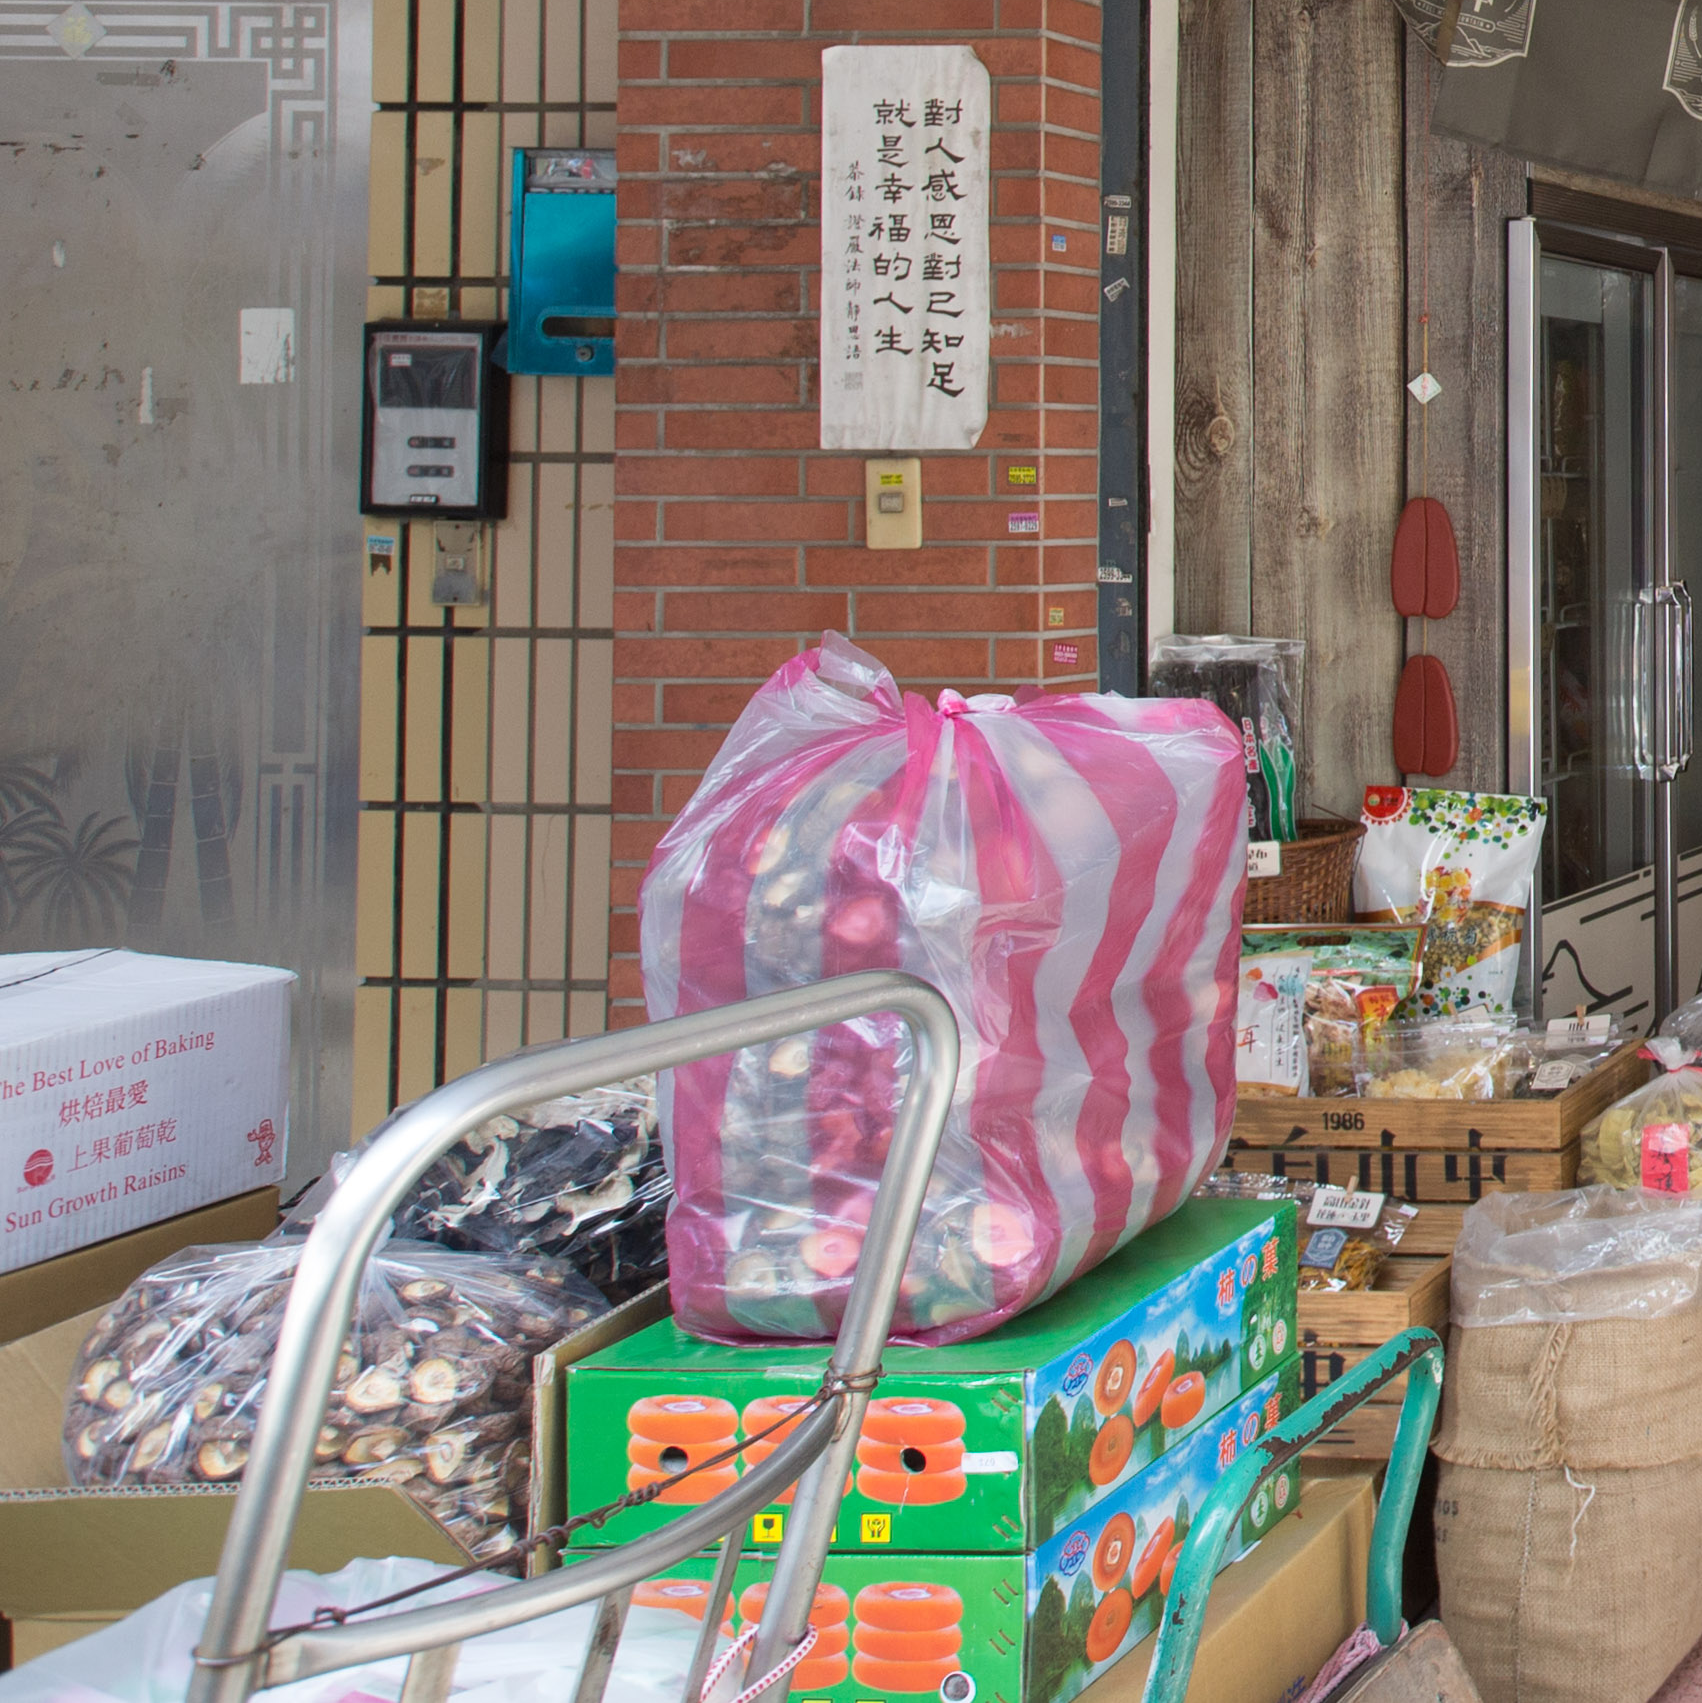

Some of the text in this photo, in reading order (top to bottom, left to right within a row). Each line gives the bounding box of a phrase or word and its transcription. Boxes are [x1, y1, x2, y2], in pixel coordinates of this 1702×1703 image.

[868, 99, 914, 355] 就是幸福的人生
[921, 99, 966, 397] 對人感恩對己知足
[0, 1030, 215, 1099] he Best Love of Baking
[59, 1079, 149, 1128] 烘焙最愛
[1322, 1112, 1365, 1131] 1986
[66, 1117, 178, 1173] 上果葡萄乾
[5, 1163, 186, 1233] Sun Growth Raisins
[1217, 1235, 1280, 1307] 柿の菓
